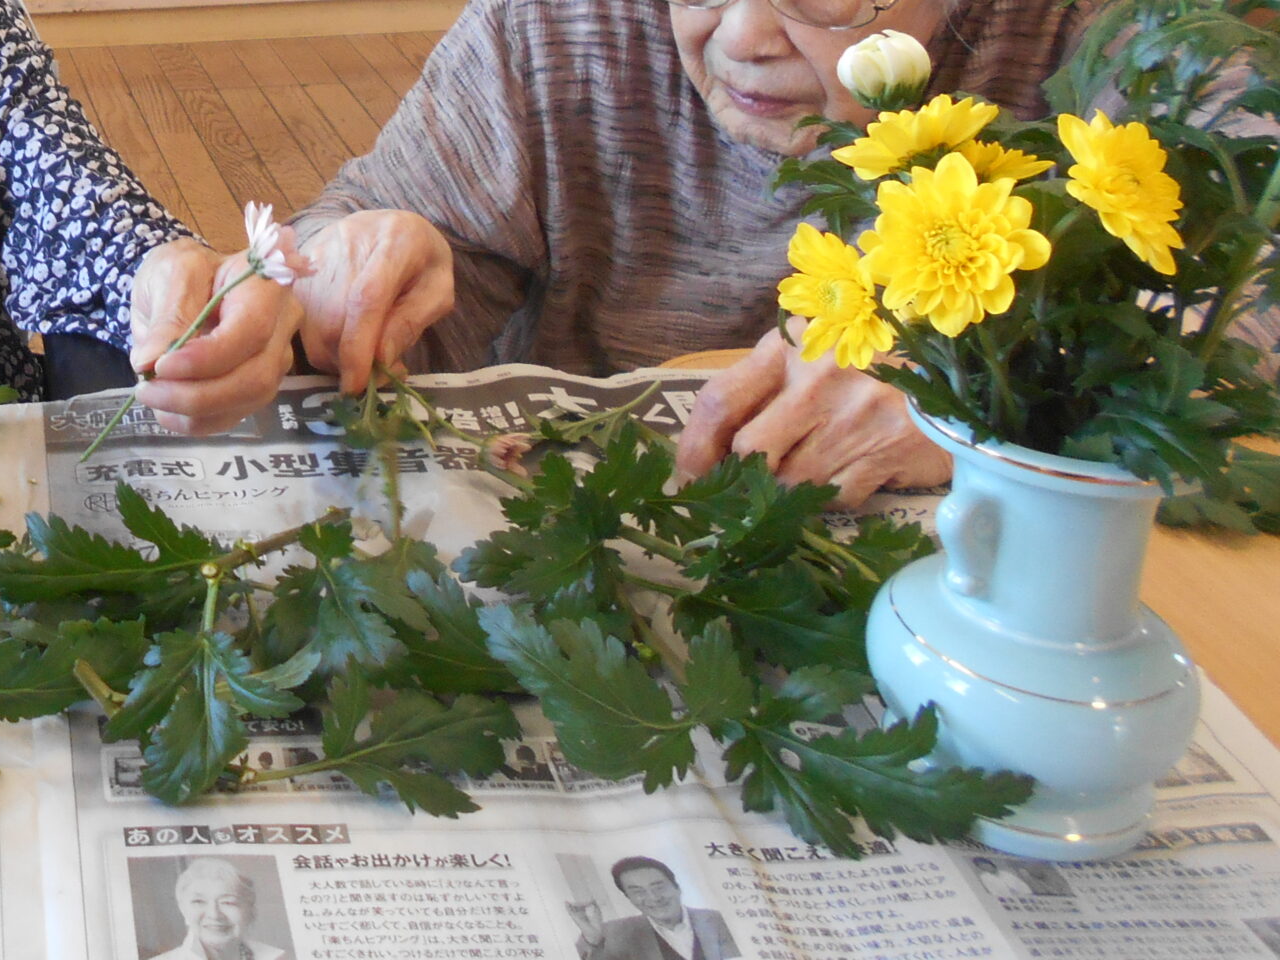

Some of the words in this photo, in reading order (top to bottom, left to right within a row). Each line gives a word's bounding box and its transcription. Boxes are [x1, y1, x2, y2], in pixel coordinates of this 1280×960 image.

[85, 458, 197, 482] 充電式
[216, 444, 489, 481] 小型集音器
[127, 826, 346, 844] あの人もオススメ
[292, 852, 512, 869] 会話やお出かけが楽しく!
